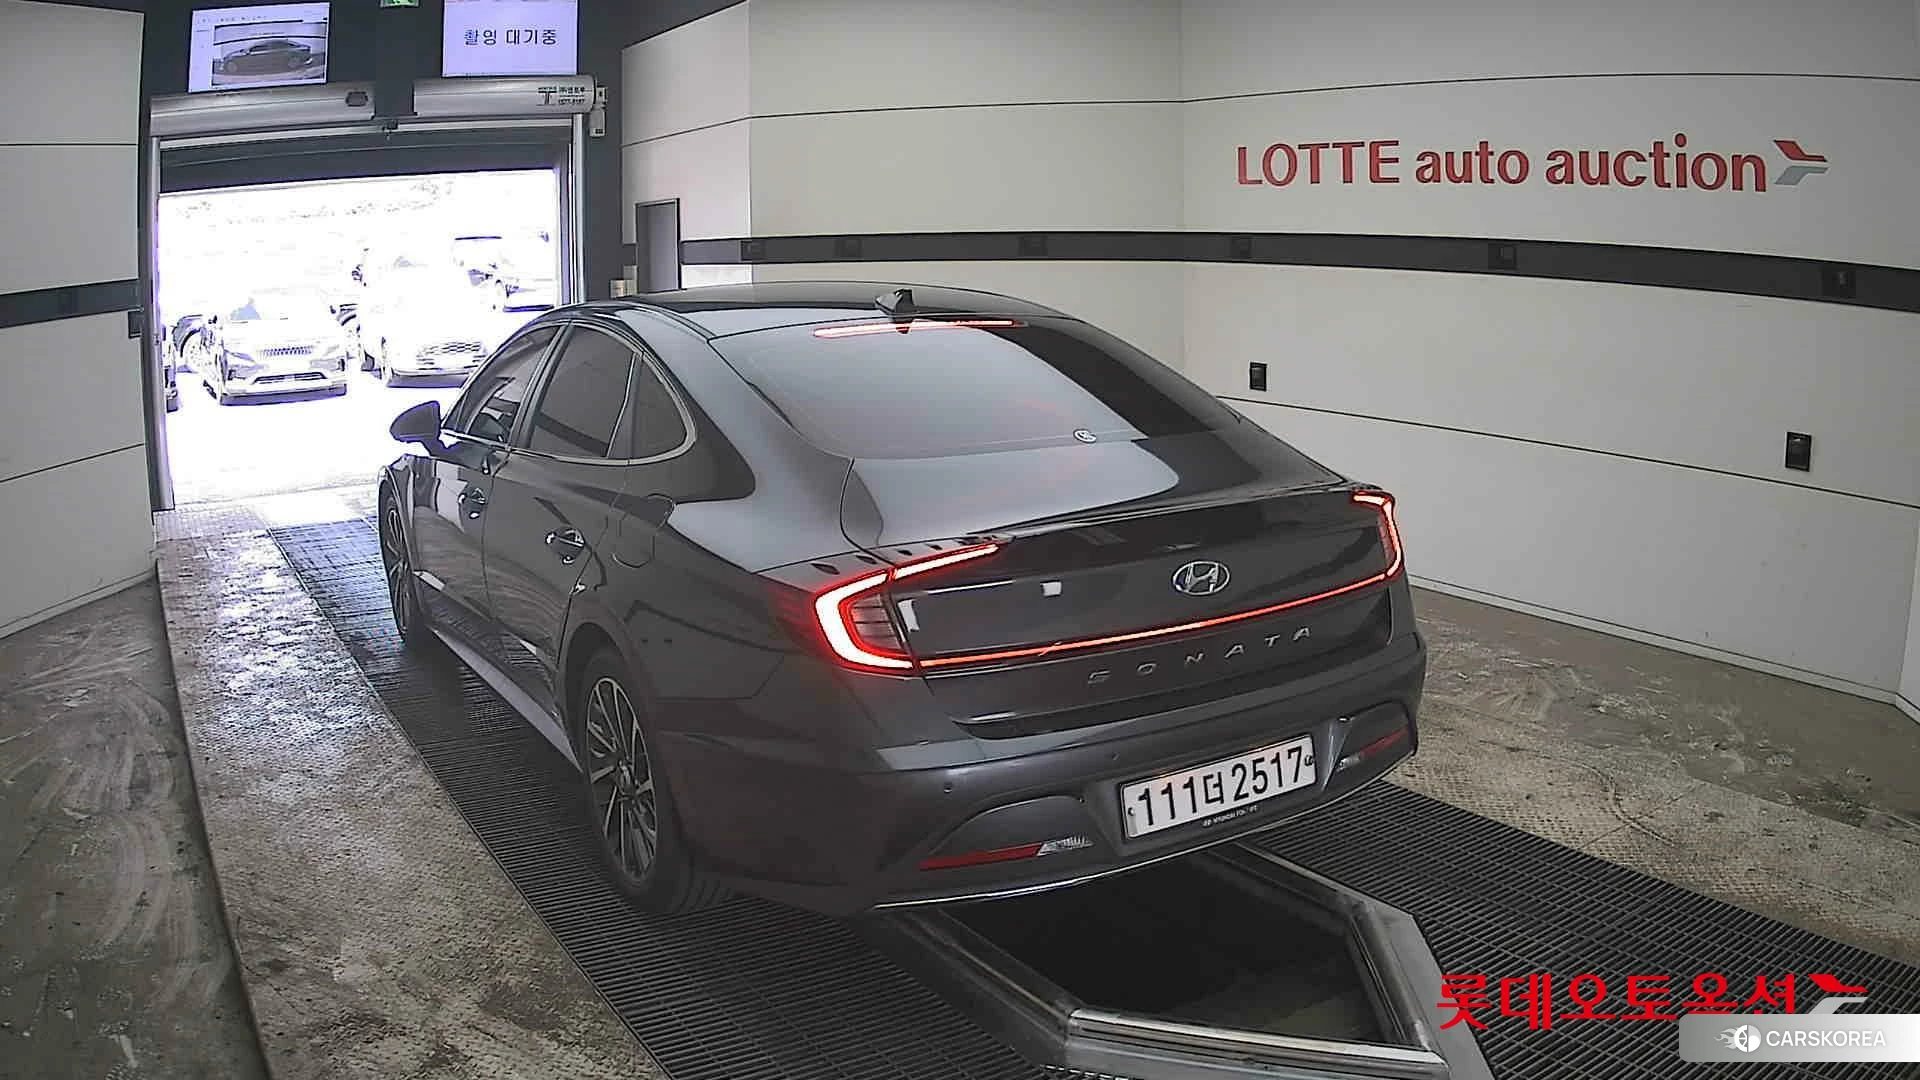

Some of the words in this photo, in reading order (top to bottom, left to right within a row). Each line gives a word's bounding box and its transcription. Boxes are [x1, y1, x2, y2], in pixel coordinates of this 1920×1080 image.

[506, 29, 557, 45] 대기중
[1237, 140, 1400, 187] LOTTE
[1415, 141, 1530, 184] auto
[1546, 132, 1767, 192] auction
[1087, 626, 1312, 685] SONATA
[1137, 745, 1303, 826] 111더2517
